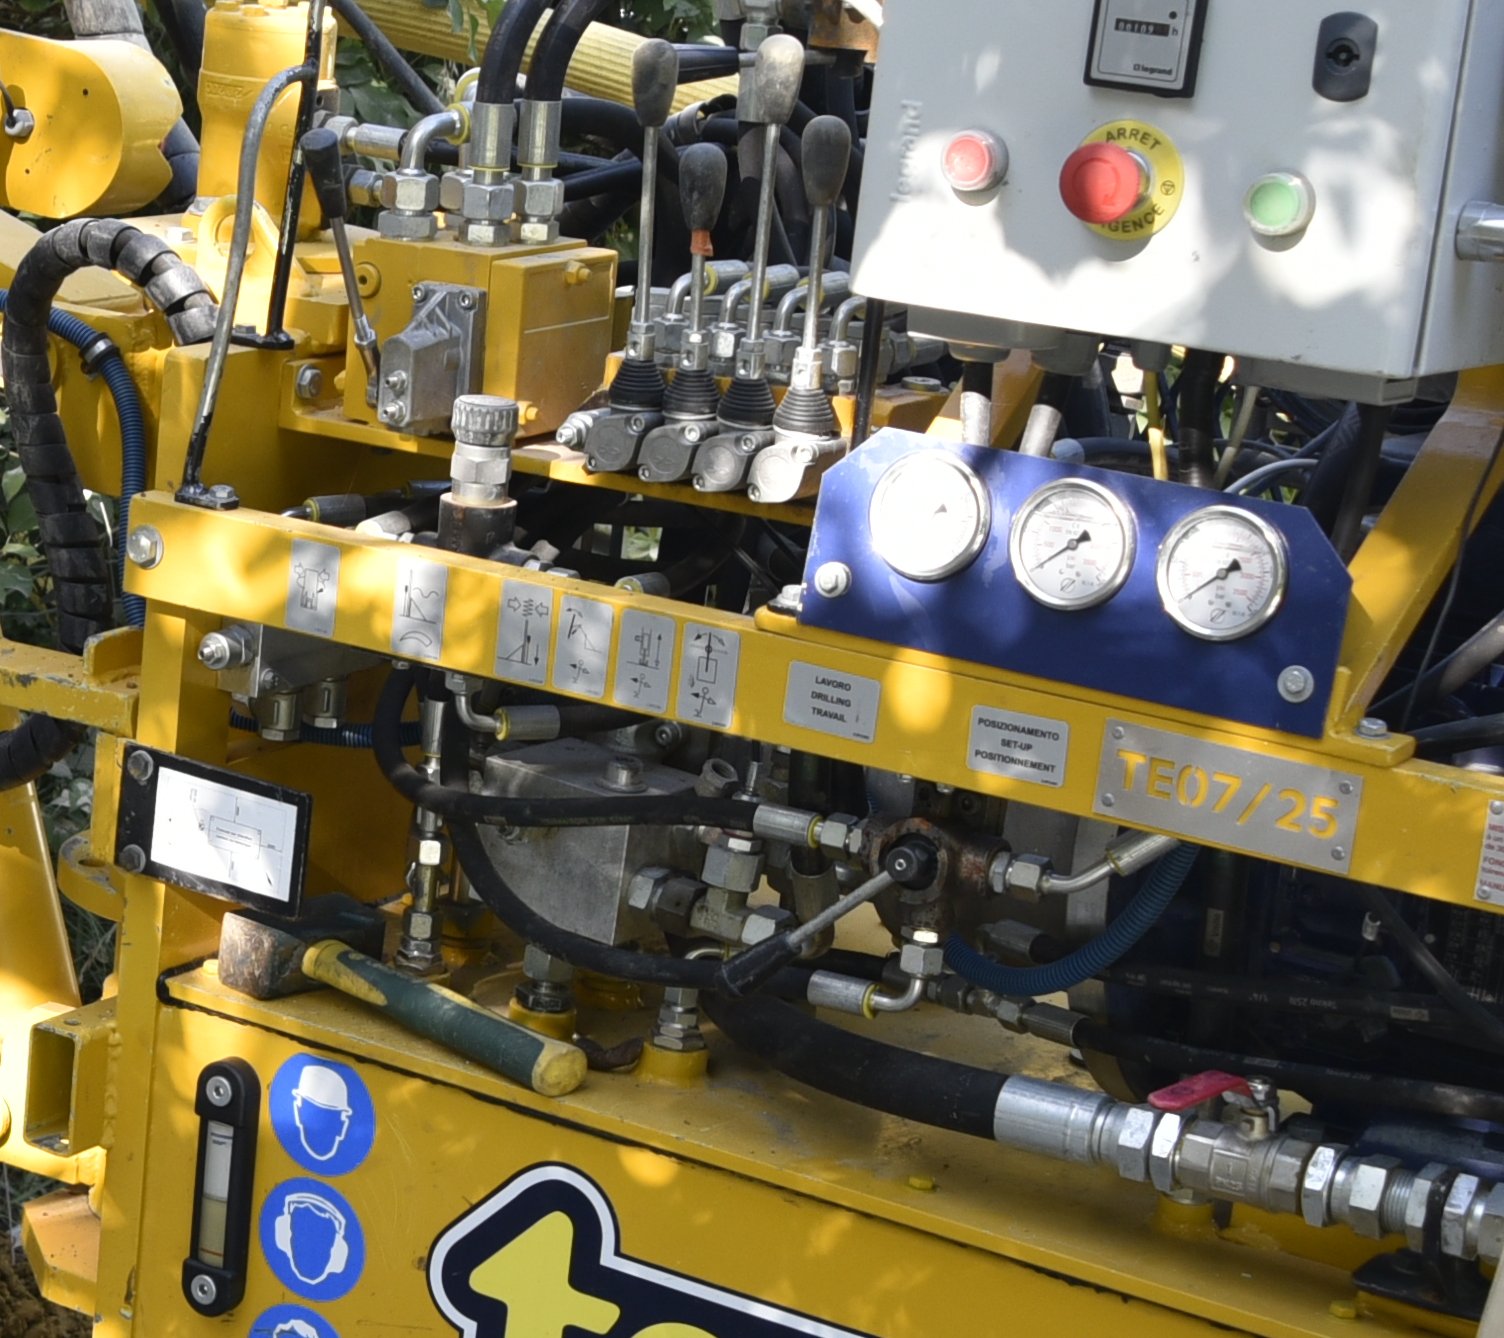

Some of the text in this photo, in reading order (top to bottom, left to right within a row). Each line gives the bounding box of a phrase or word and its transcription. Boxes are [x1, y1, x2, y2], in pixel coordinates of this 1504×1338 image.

[1140, 64, 1173, 76] legrand
[1105, 127, 1162, 150] ARRET
[1101, 202, 1166, 233] GENCE
[814, 675, 852, 692] LAVORO
[810, 690, 852, 708] DRILLING
[811, 706, 847, 723] TRAVAIL
[977, 717, 1060, 742] POSIZIONAMENTO
[1000, 738, 1033, 752] SET-UP
[974, 749, 1056, 774] POSITIONNEMENT
[1116, 748, 1340, 839] TE07/25
